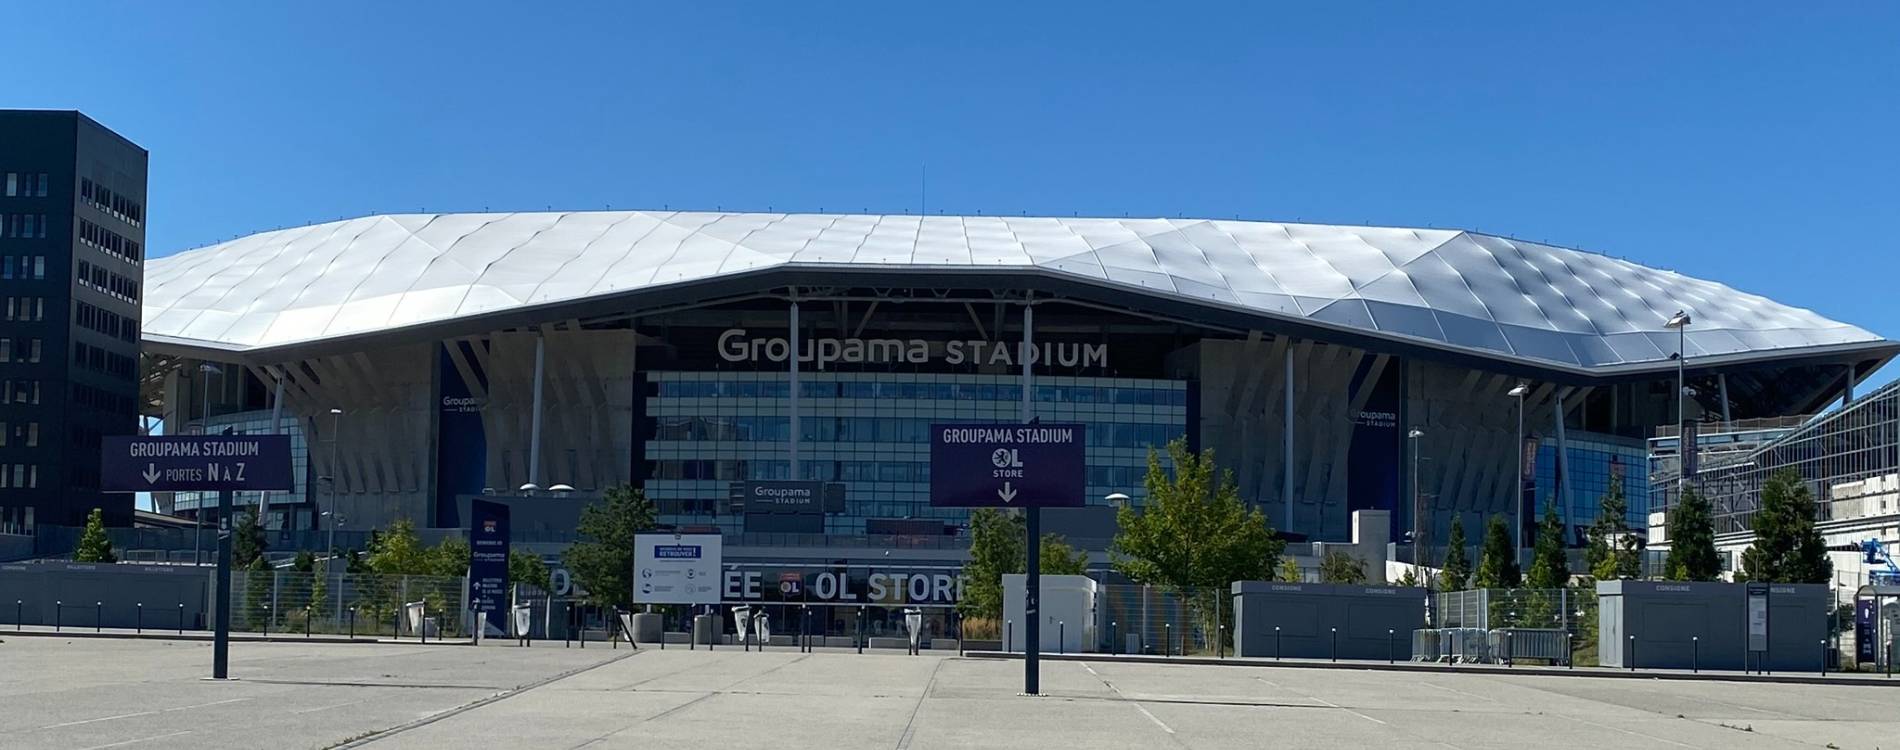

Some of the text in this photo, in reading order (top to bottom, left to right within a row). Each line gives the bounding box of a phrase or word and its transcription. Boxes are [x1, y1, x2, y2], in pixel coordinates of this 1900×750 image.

[717, 328, 1108, 370] Groupama STADIUM
[442, 395, 478, 407] Groupa
[1352, 409, 1396, 420] oupama
[943, 428, 1073, 443] GROUPAMA STADIUM
[130, 441, 259, 457] GROUPAMA STADIUM
[166, 469, 202, 481] PORTES
[207, 463, 219, 481] N
[235, 462, 246, 481] Z
[993, 469, 1024, 478] STORE
[755, 486, 811, 498] Groupama
[815, 572, 857, 600] OL
[1769, 586, 1796, 594] NSIGNE
